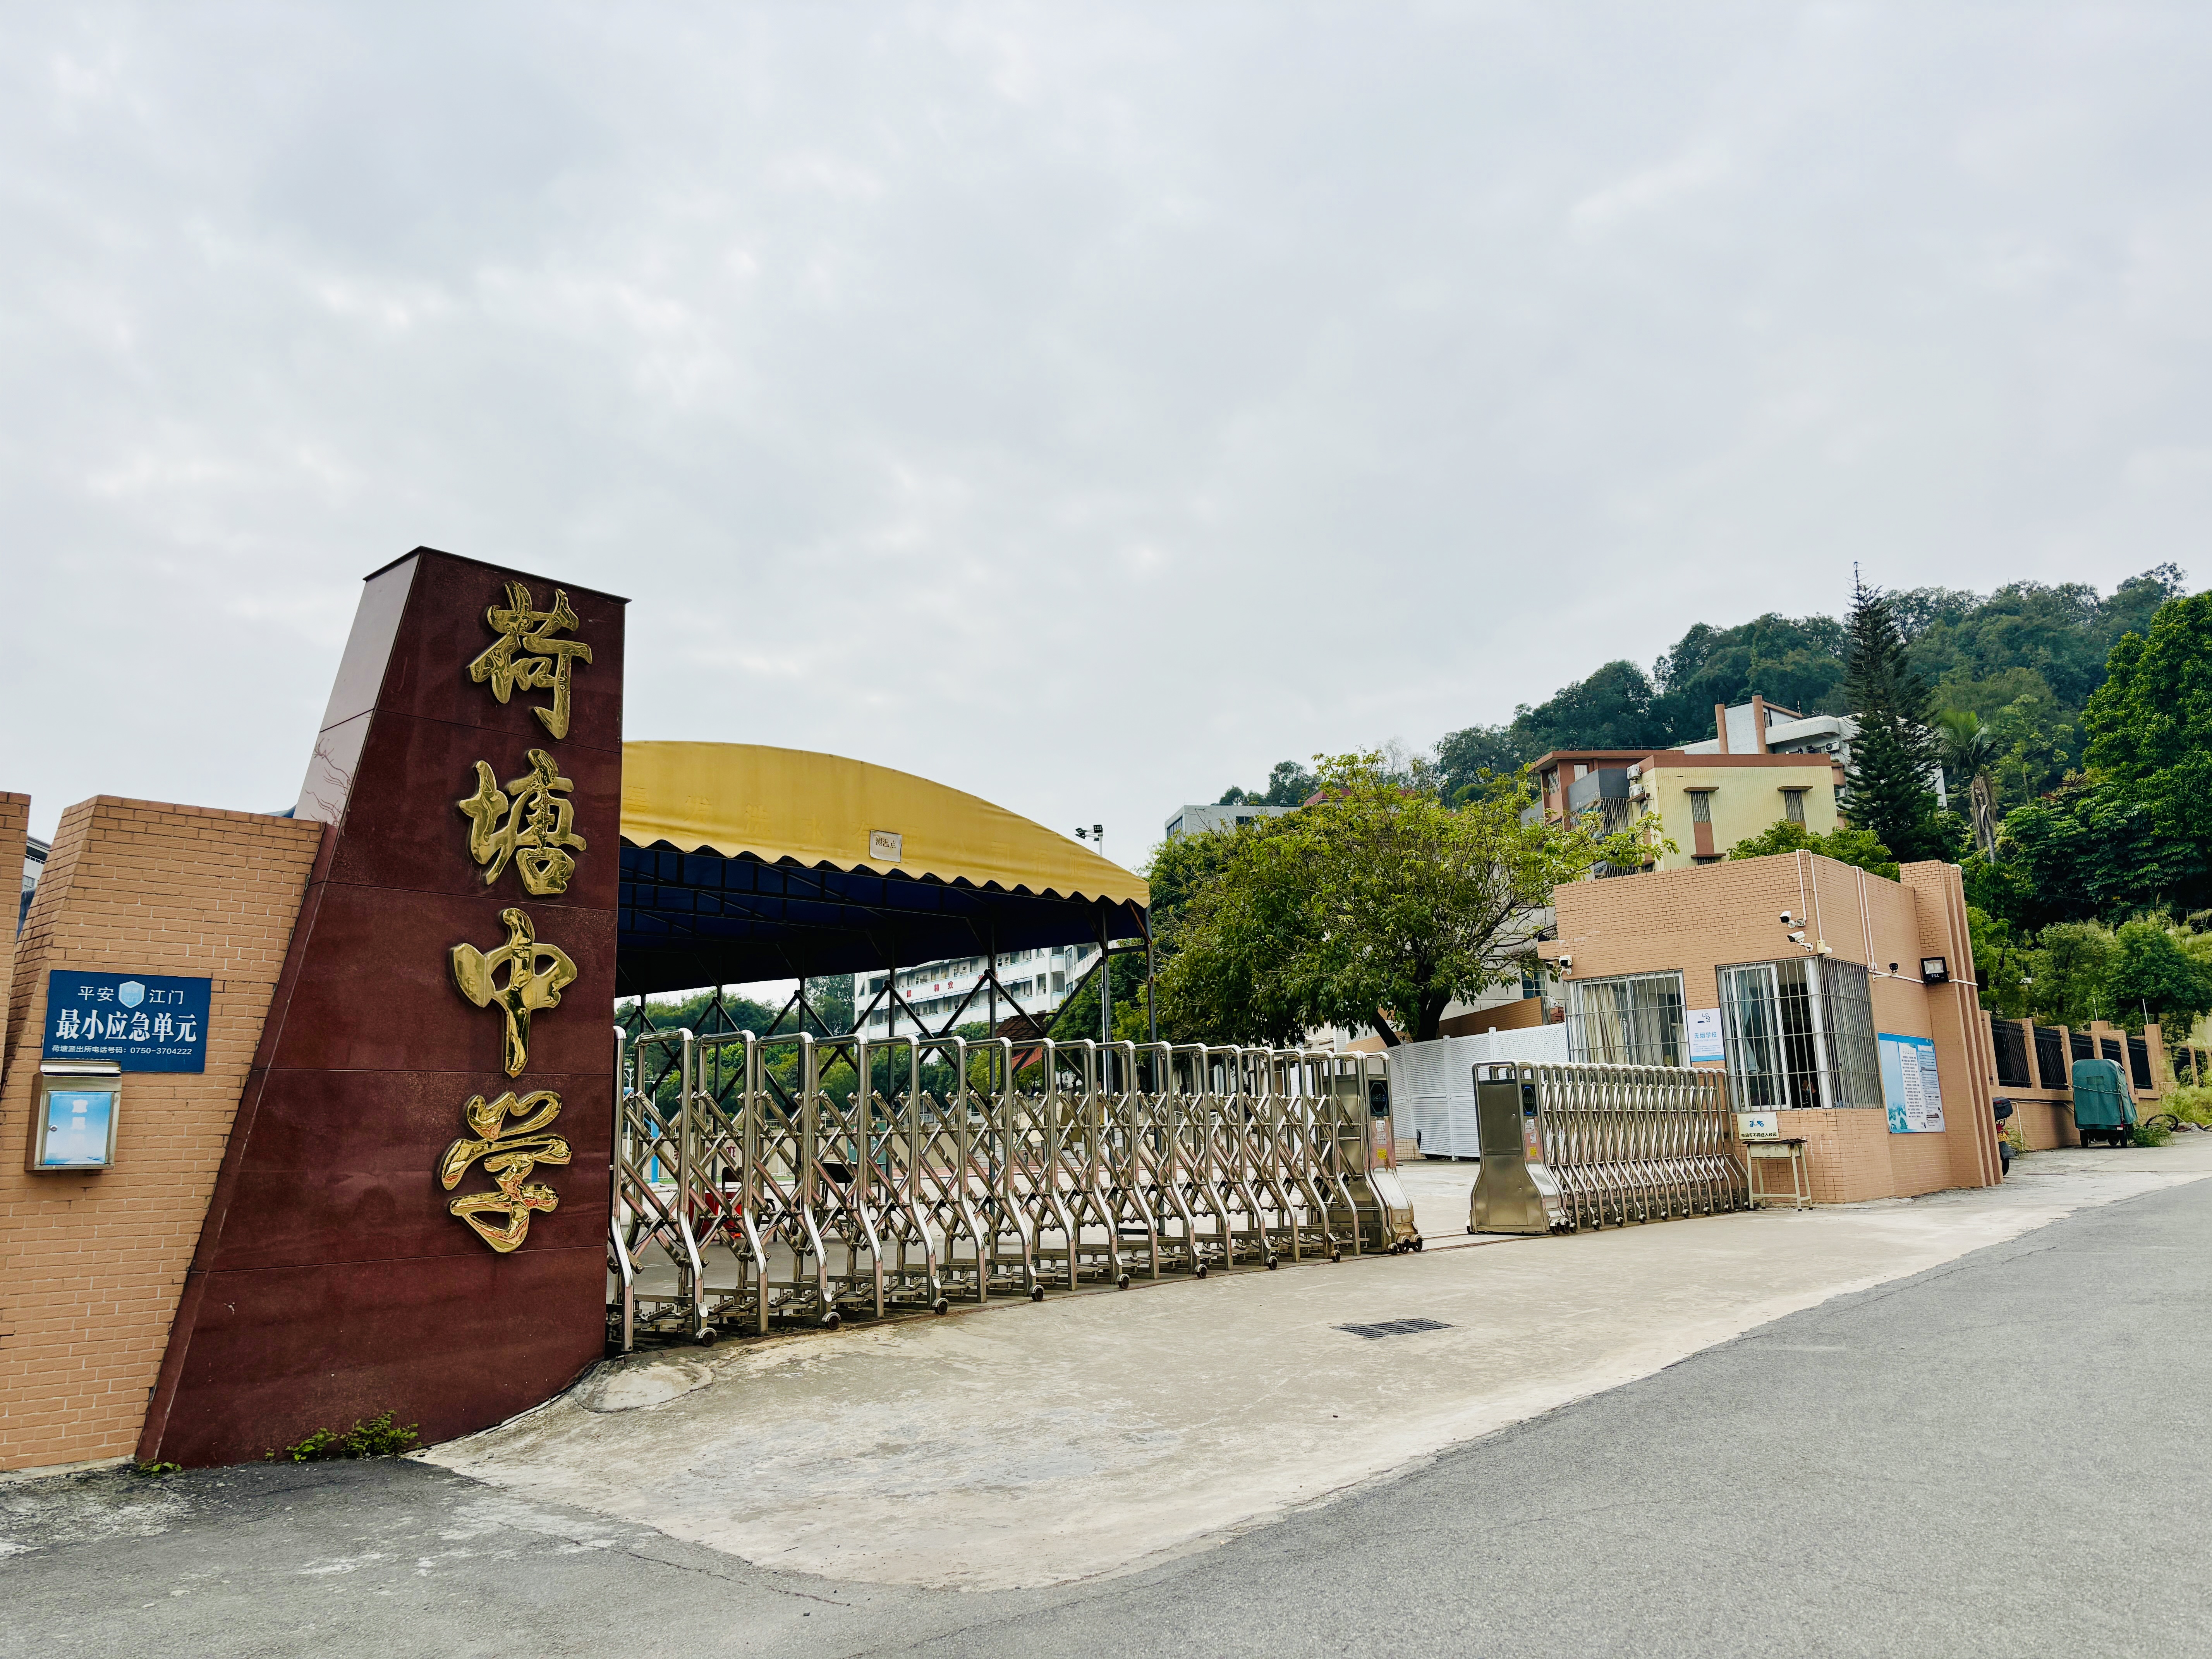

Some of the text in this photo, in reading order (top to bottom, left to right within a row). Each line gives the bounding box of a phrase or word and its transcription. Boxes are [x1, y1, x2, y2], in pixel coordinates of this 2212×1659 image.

[876, 838, 896, 848] 测温点
[441, 580, 592, 1253] 荷塘中学
[78, 986, 184, 1005] 平安 江门
[56, 1008, 197, 1042] 最小应急单元
